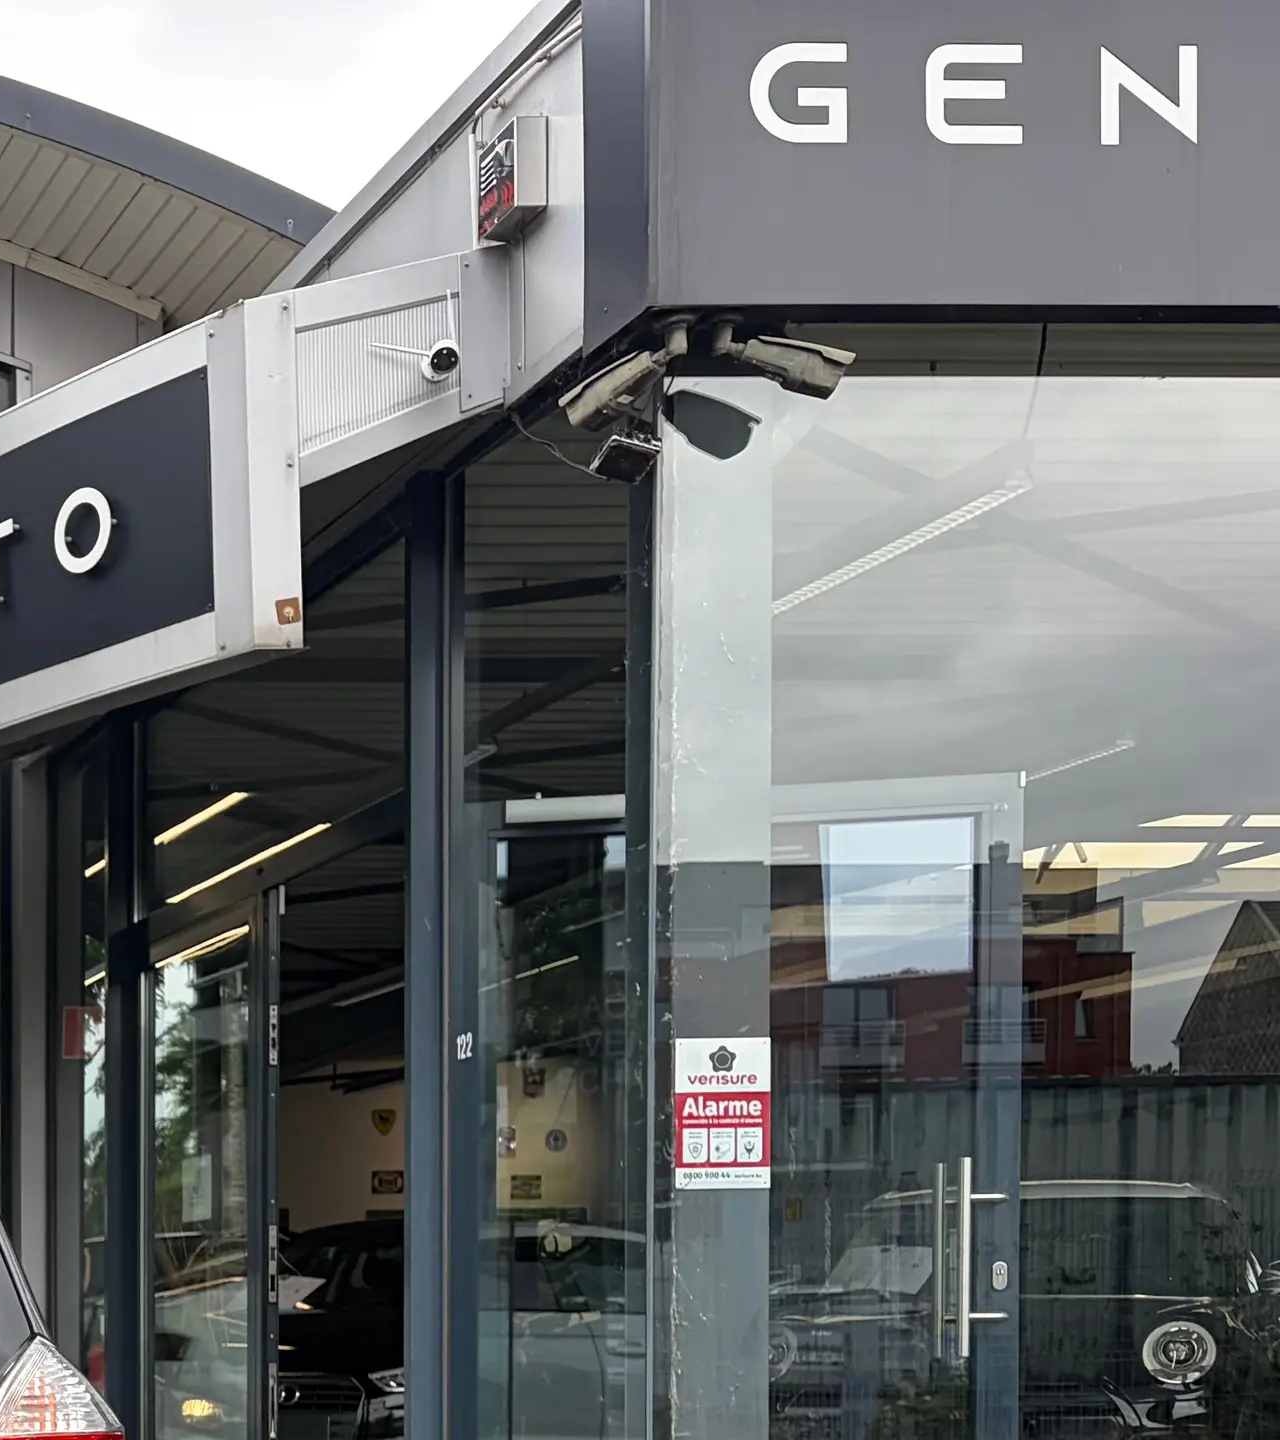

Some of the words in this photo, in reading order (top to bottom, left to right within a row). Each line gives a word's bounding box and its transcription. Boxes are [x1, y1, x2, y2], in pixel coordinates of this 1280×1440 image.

[749, 42, 1198, 146] GEN
[456, 1030, 473, 1061] 122
[687, 1074, 757, 1085] verisure
[682, 1096, 762, 1117] Alarme
